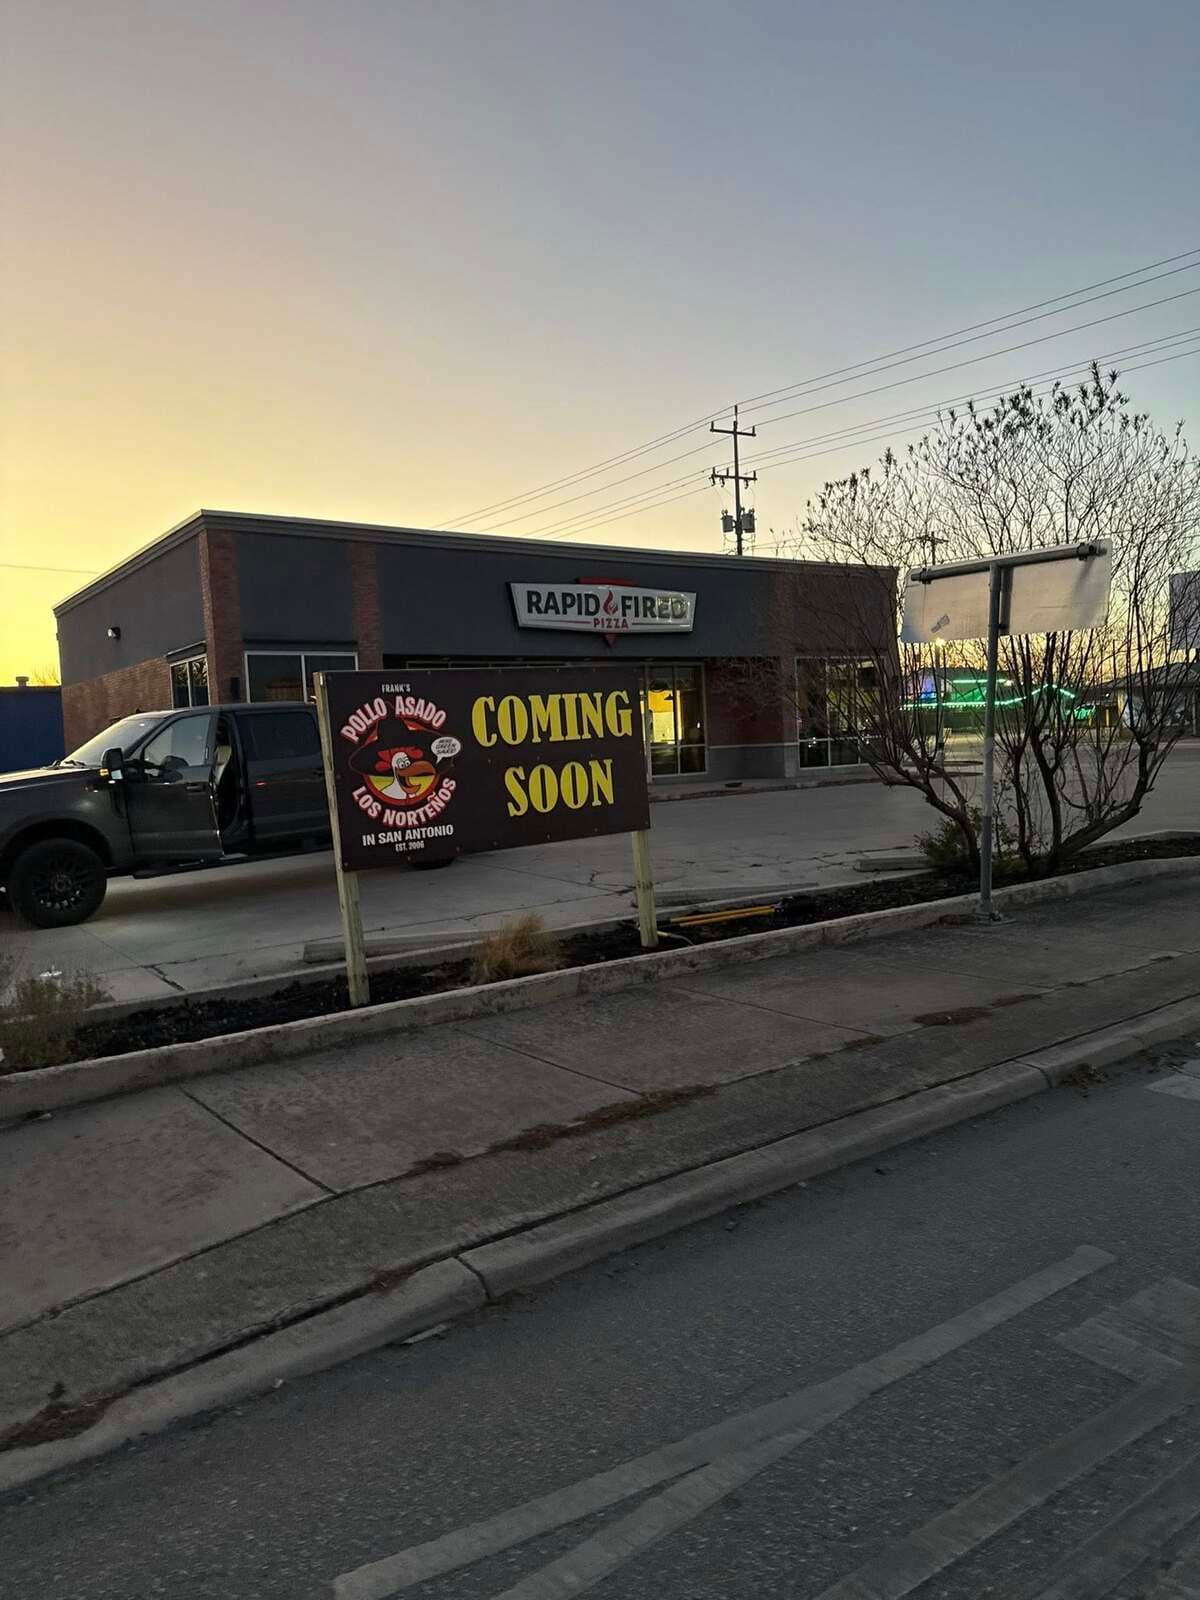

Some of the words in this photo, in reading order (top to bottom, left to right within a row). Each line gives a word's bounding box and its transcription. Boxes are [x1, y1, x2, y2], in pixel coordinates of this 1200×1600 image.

[526, 590, 600, 616] RAPID
[621, 595, 689, 619] FIRED
[593, 618, 629, 629] PIZZA
[381, 683, 411, 693] FRANK'S
[340, 697, 387, 742] POLLO
[395, 695, 447, 728] ASADO
[471, 690, 633, 747] COMING
[352, 785, 382, 817] LOS
[383, 778, 456, 826] NORTEÑOS
[504, 759, 615, 817] SOON
[362, 834, 376, 846] IN
[378, 831, 402, 844] SAN
[405, 824, 454, 840] ANTONIO
[395, 843, 407, 852] EST.
